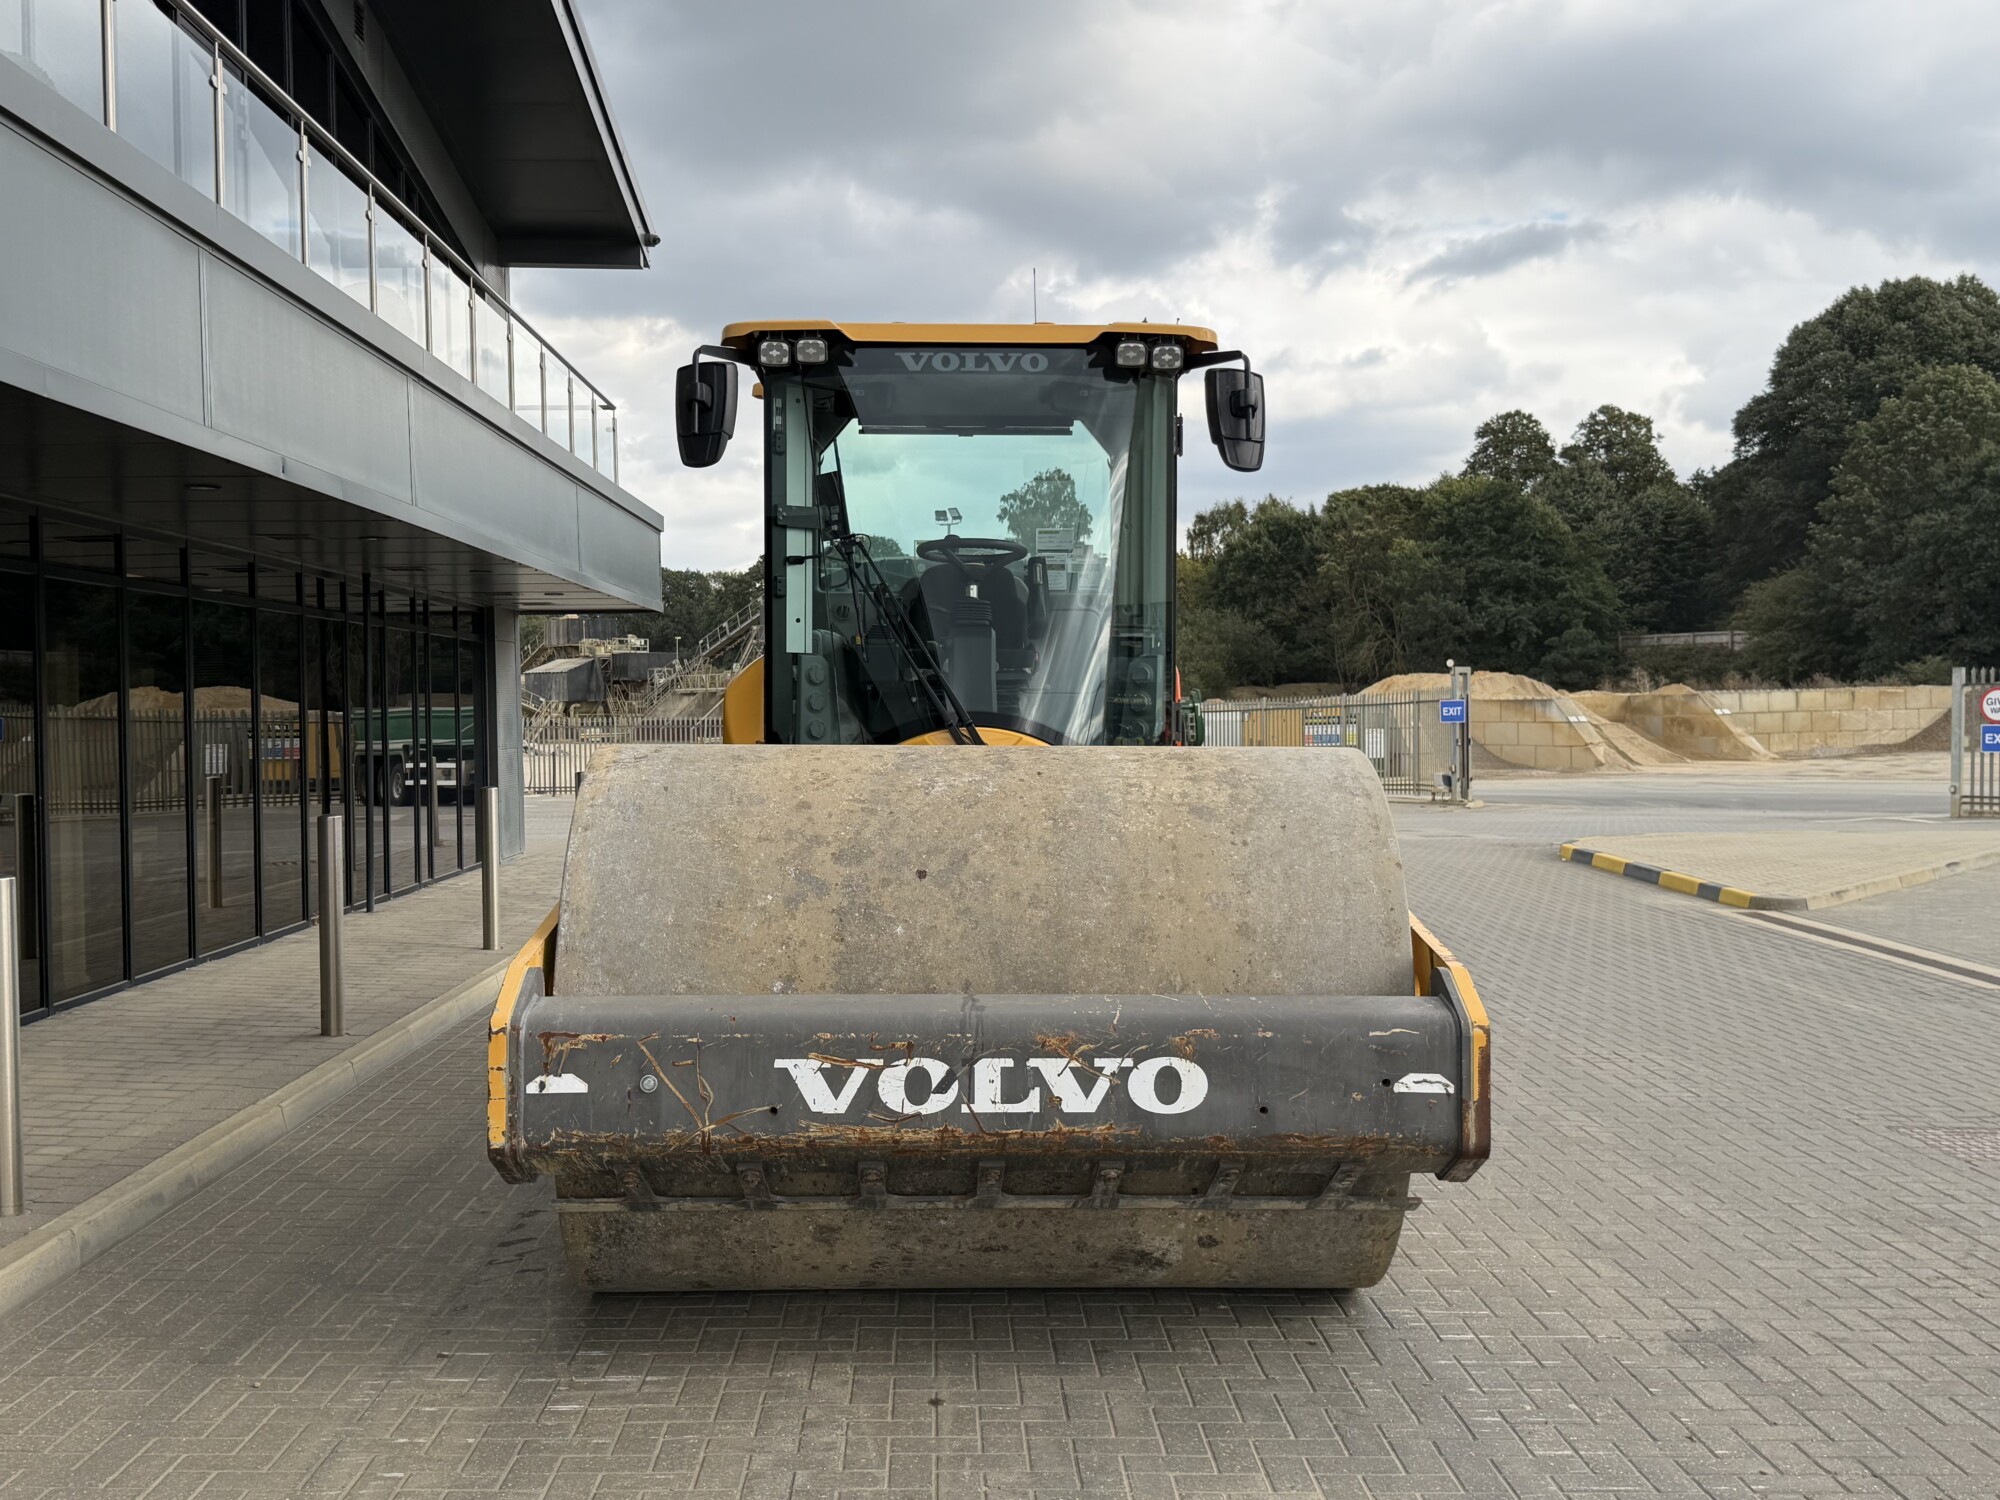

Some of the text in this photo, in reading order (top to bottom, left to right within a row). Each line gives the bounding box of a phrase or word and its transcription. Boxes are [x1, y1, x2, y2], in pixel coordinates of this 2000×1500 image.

[894, 352, 1049, 373] VOLVO
[1442, 706, 1462, 716] EXIT
[774, 1056, 1208, 1115] VOLVO
